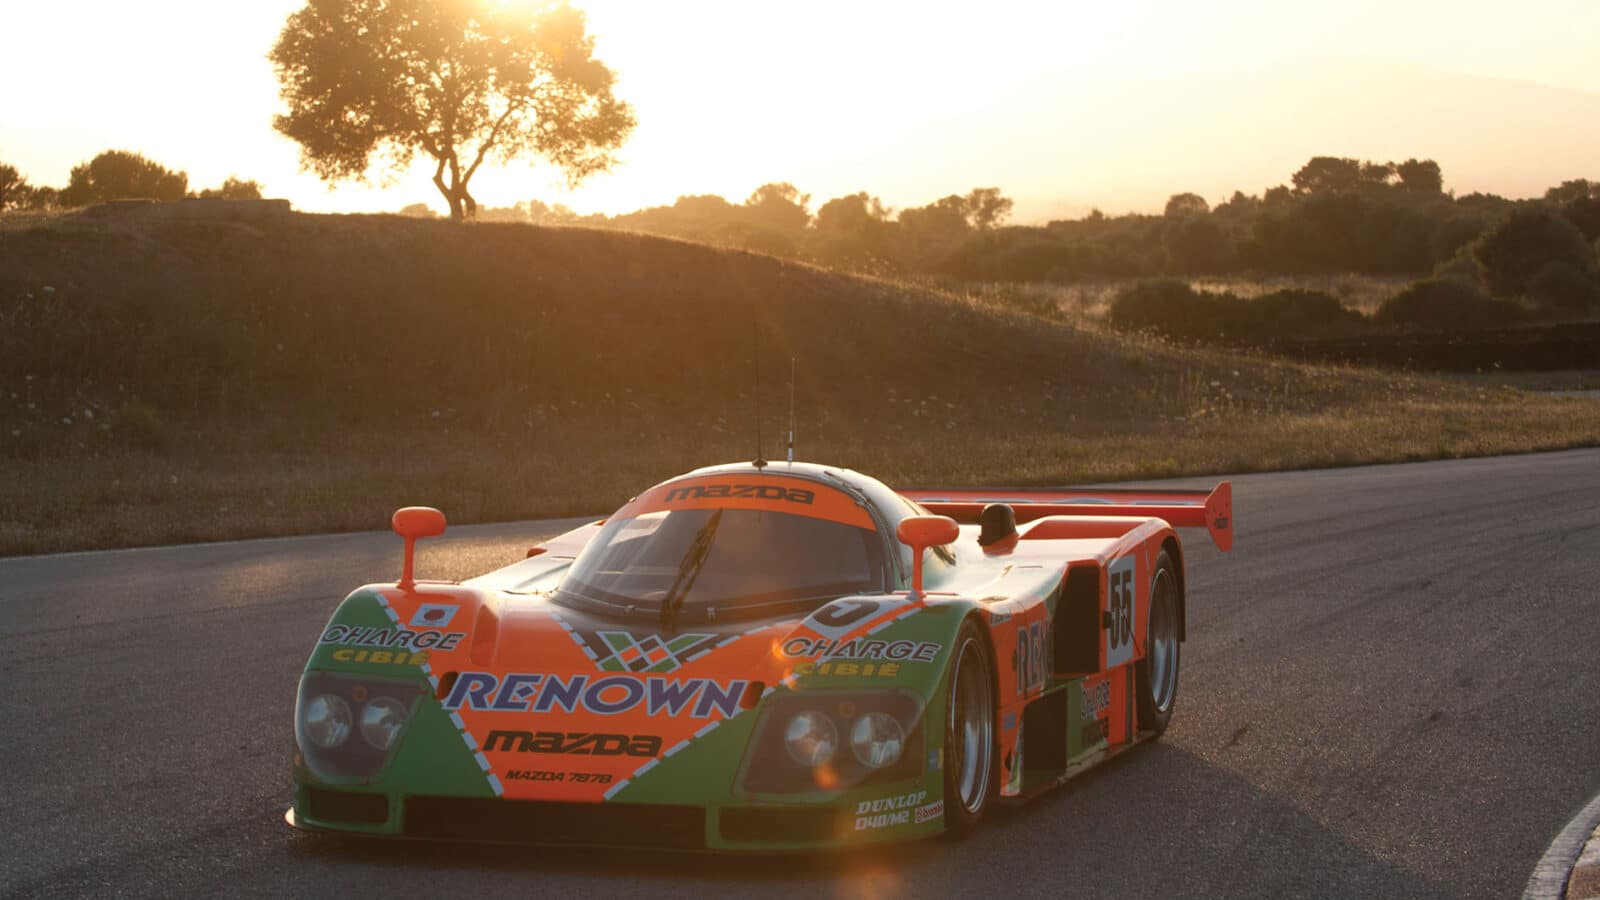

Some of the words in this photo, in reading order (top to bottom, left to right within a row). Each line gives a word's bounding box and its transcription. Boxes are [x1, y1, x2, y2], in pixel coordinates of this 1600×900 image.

[664, 484, 815, 504] mazda
[320, 624, 467, 651] CHARGE
[782, 637, 942, 662] CHARGE
[442, 671, 748, 719] RENOWN
[482, 730, 663, 757] mazda
[505, 769, 564, 782] MAZDA
[568, 772, 613, 784] 787B
[856, 791, 927, 815] DUNLOP
